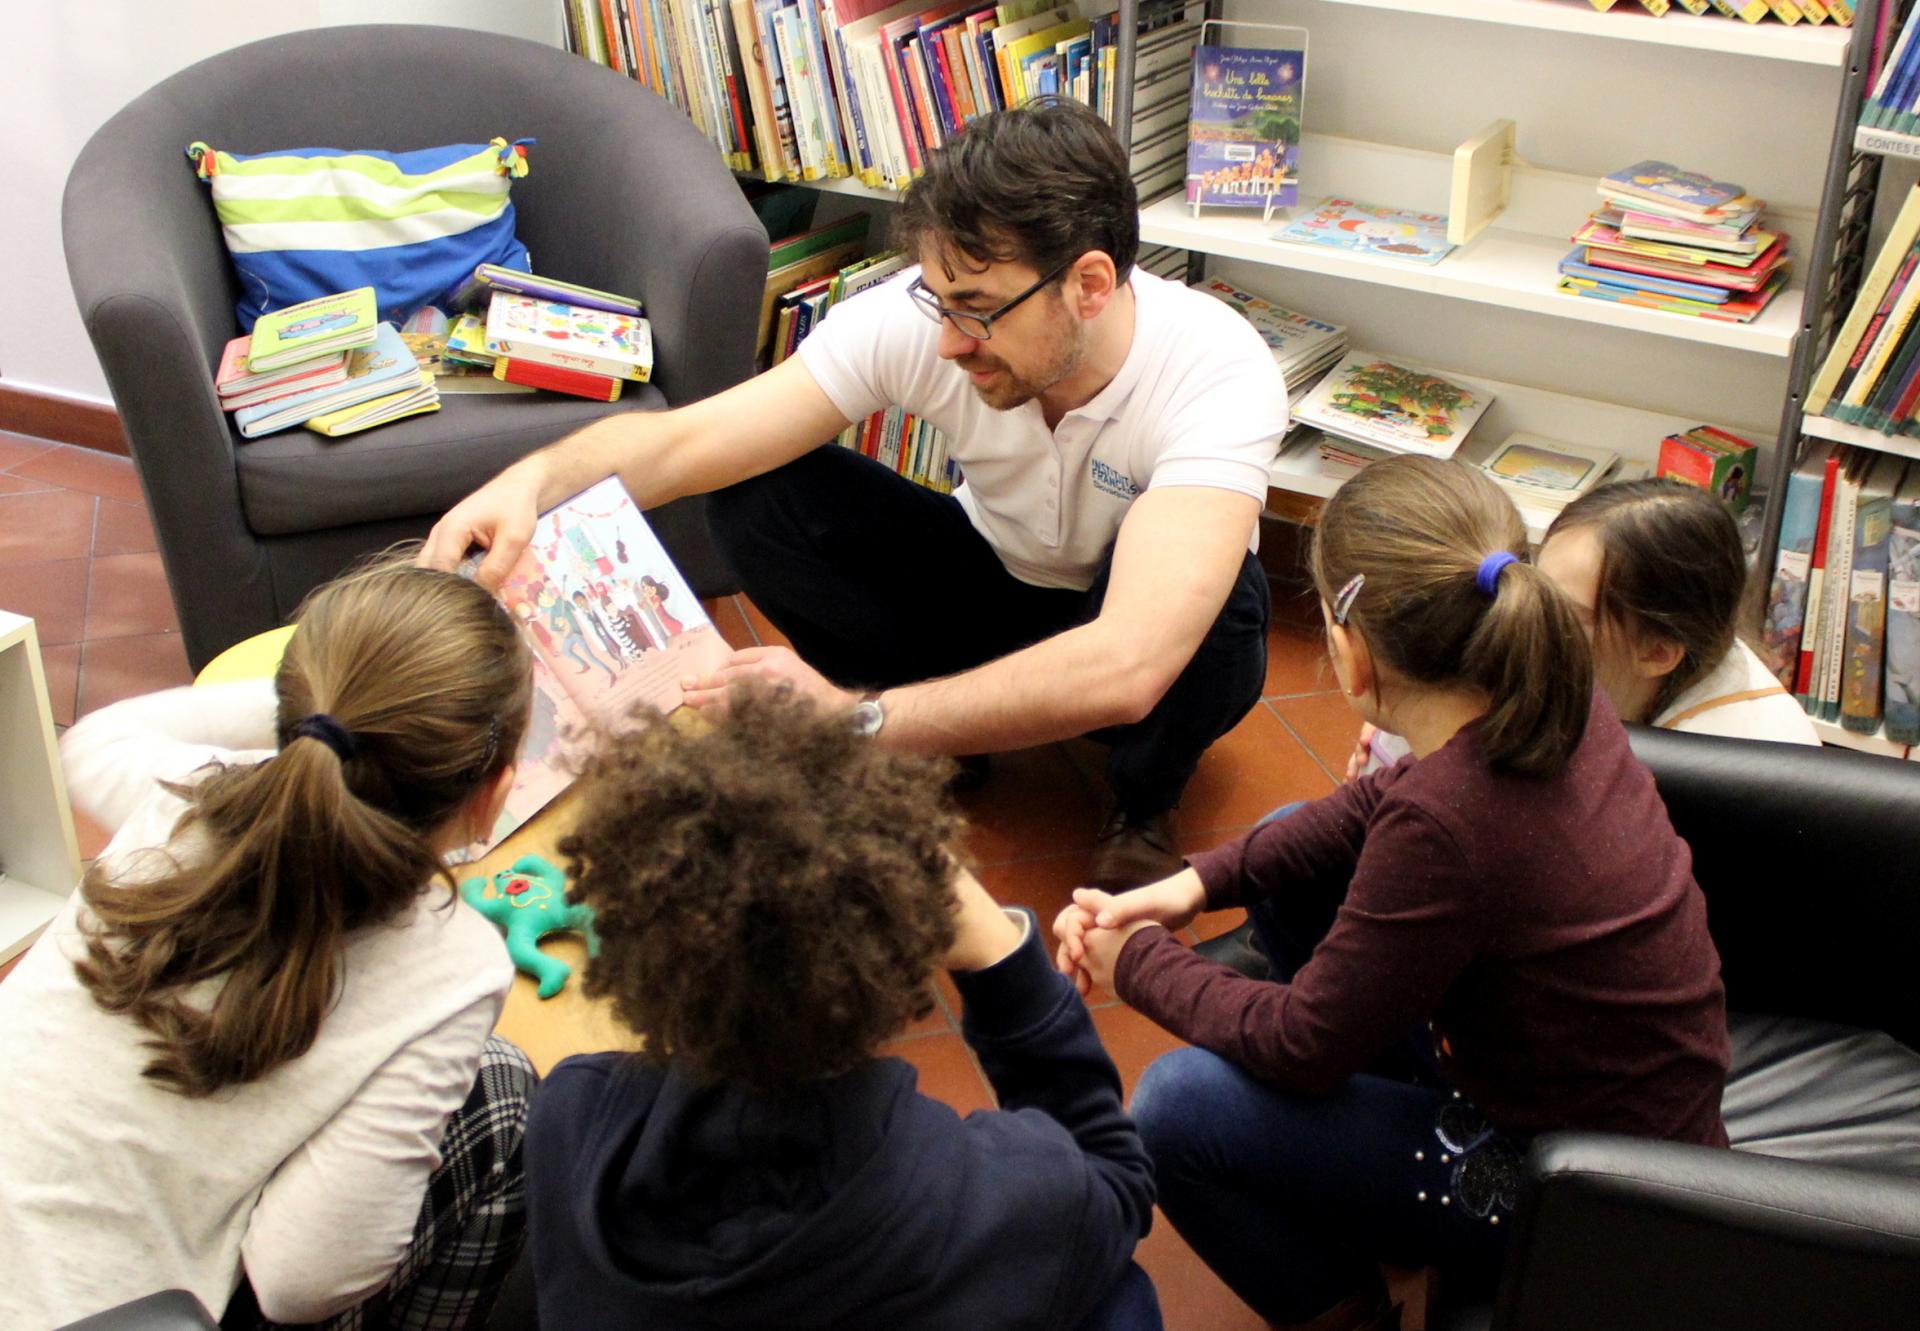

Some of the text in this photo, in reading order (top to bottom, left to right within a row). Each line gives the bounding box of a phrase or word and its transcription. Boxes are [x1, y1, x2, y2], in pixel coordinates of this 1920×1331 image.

[1225, 68, 1245, 85] Une
[1866, 137, 1911, 154] CONTES
[1092, 459, 1129, 490] INSTITUT
